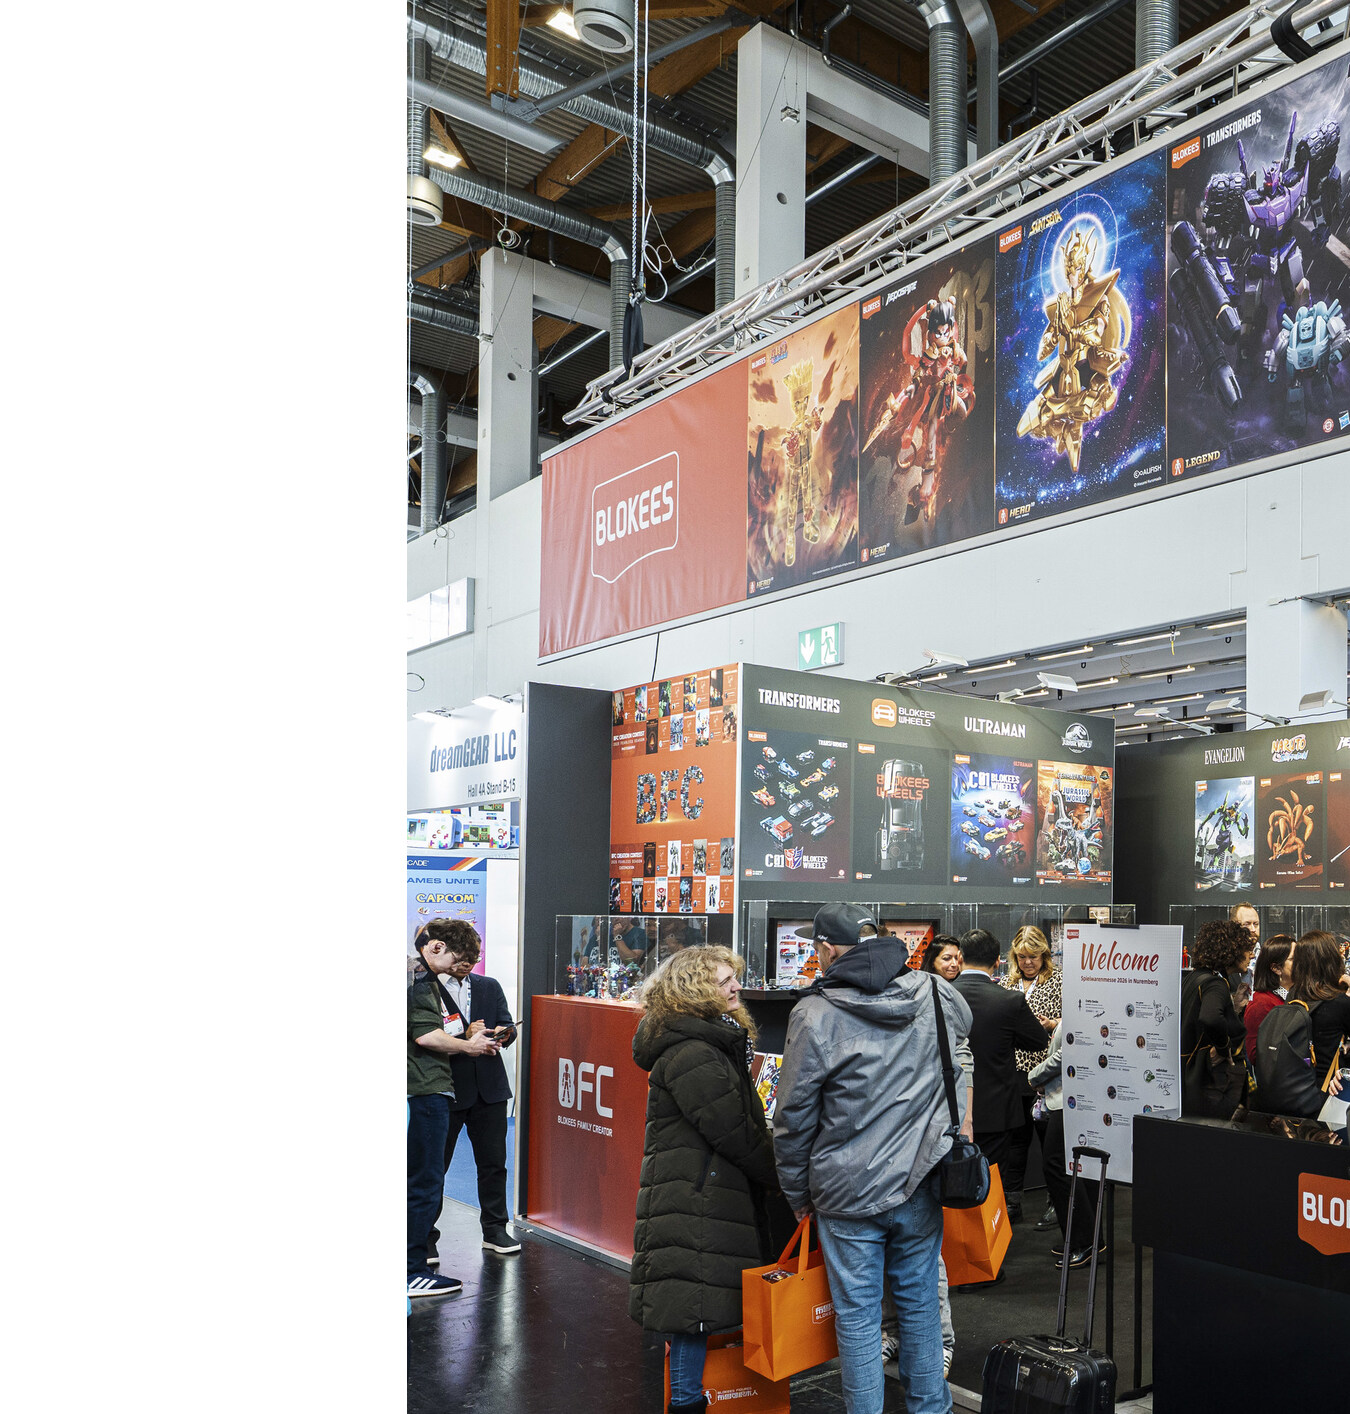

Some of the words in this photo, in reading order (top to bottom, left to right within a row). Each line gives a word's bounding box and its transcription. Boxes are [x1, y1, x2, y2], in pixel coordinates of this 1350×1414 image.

[1206, 109, 1262, 148] TRANSFORMERS
[1172, 141, 1200, 163] BLOKEES
[1000, 230, 1021, 247] BLOKEES
[862, 299, 881, 314] BLOKEES
[1185, 450, 1220, 468] LEGEND
[595, 480, 674, 546] BLOKEES
[1009, 504, 1031, 518] HERO
[869, 545, 887, 556] HERO
[758, 688, 841, 714] TRANSFORMERS
[898, 706, 936, 719] BLOKEES
[898, 716, 931, 727] WHEELS
[964, 716, 1026, 739] ULTRAMAN
[430, 734, 490, 773] dreamGEAR
[494, 729, 516, 763] LLC
[1271, 737, 1307, 754] NARUTO
[1204, 746, 1245, 765] EVANGELION
[876, 773, 930, 789] BOKEES
[991, 772, 1020, 784] BLOKEES
[467, 784, 478, 798] Hall
[478, 782, 486, 796] 4A
[486, 780, 502, 795] Stand
[503, 778, 516, 793] B-15
[636, 765, 705, 824] BFC
[991, 782, 1018, 792] WHEELS
[1065, 794, 1087, 803] WORLD
[803, 855, 828, 863] BLOKEES
[803, 862, 826, 870] WHEELS
[416, 893, 475, 904] CAPCOM
[1080, 940, 1160, 972] Welcome
[1080, 975, 1117, 983] Spielwarenmesse
[1133, 978, 1159, 986] Nuremberg
[558, 1057, 614, 1119] BFC
[557, 1115, 577, 1127] BLOKEES
[576, 1120, 592, 1131] FAMILY
[592, 1124, 613, 1137] CREATOR
